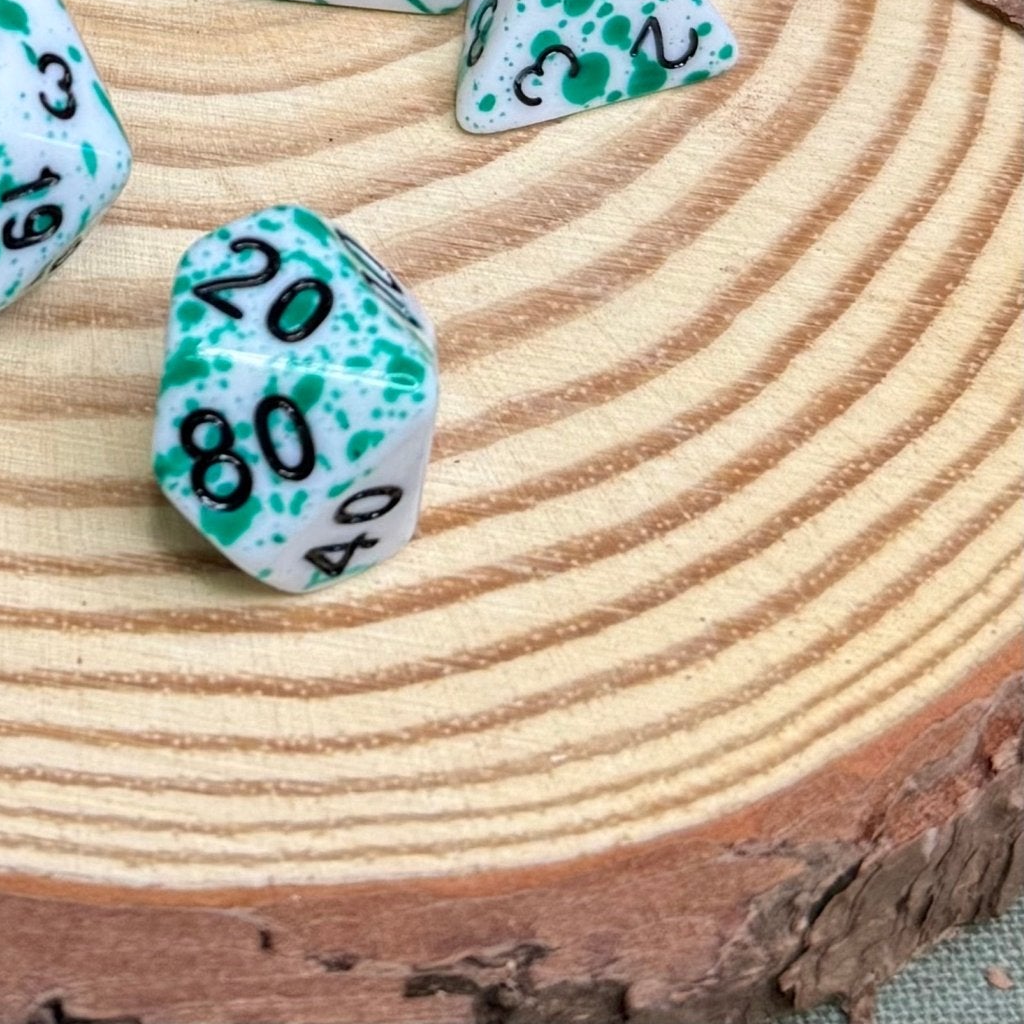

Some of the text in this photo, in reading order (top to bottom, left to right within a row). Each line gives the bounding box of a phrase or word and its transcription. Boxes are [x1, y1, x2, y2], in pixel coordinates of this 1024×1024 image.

[513, 44, 581, 107] 3
[630, 16, 699, 70] 2
[37, 53, 78, 120] 3
[193, 237, 334, 343] 20
[180, 394, 316, 512] 80
